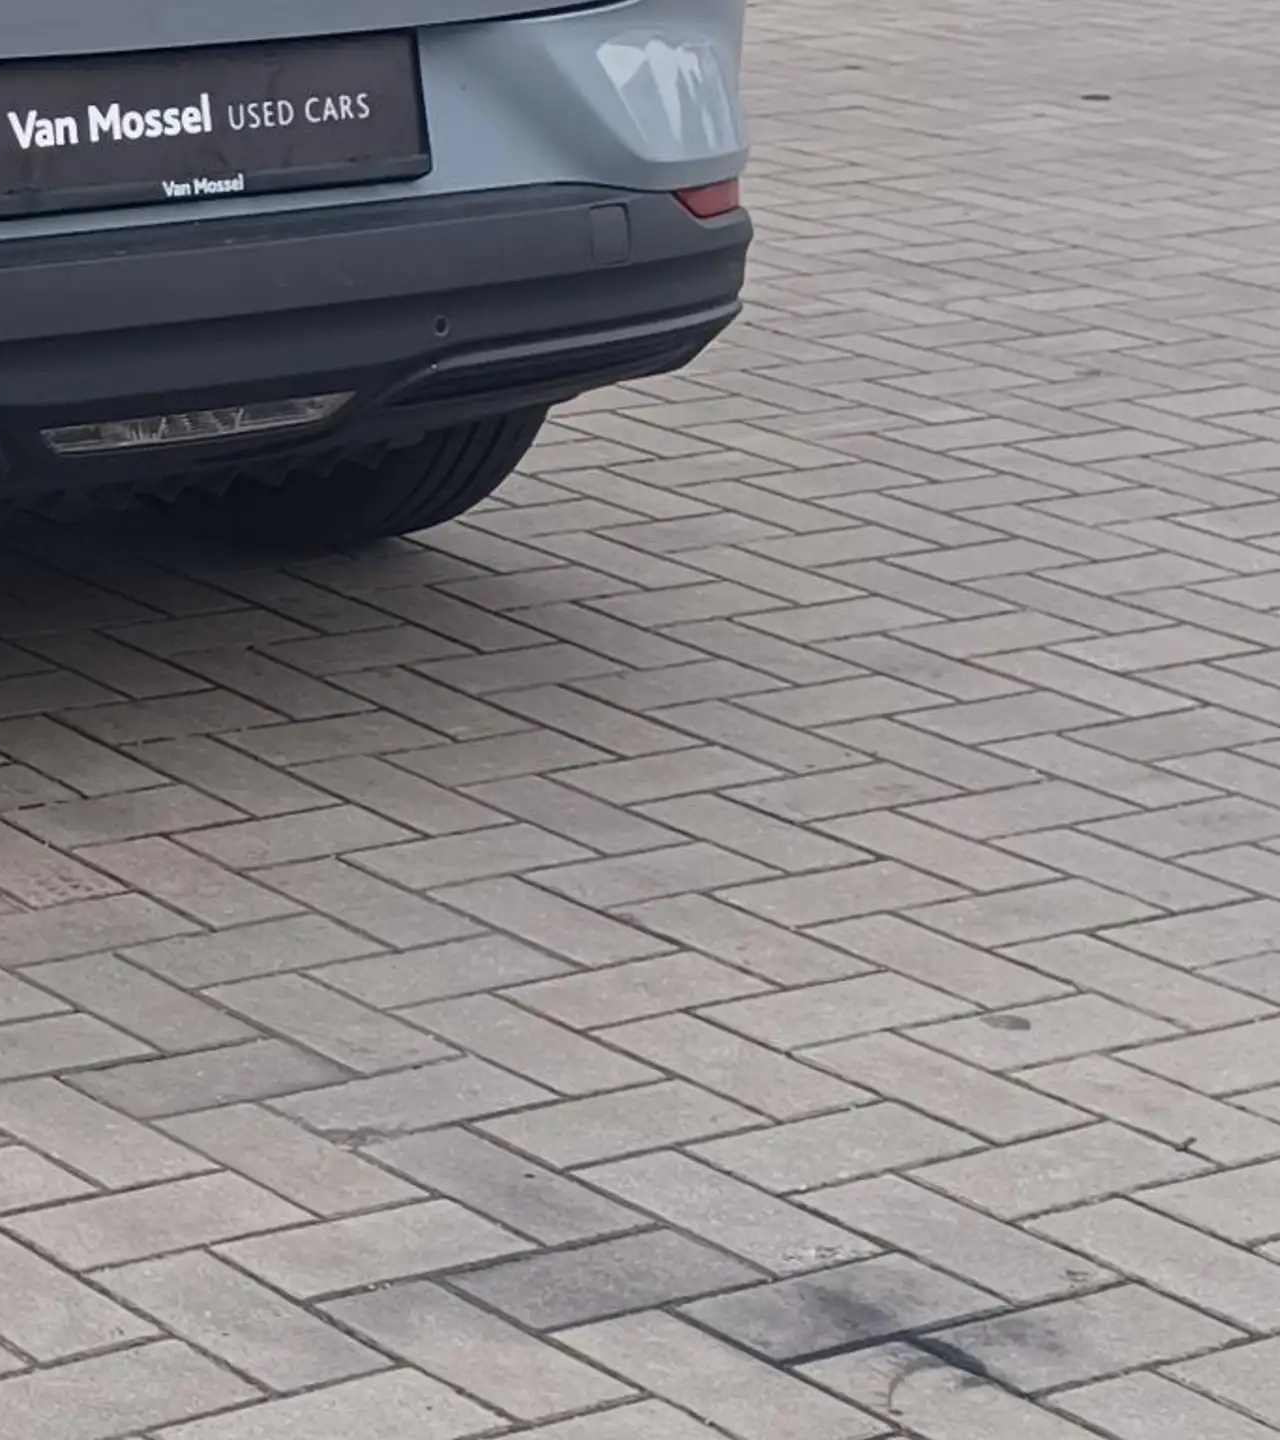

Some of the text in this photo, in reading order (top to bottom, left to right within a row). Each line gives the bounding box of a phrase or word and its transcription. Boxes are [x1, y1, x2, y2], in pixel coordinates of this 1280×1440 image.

[7, 92, 372, 150] Van Mossel USED CARS
[162, 172, 244, 198] Van Mossel
